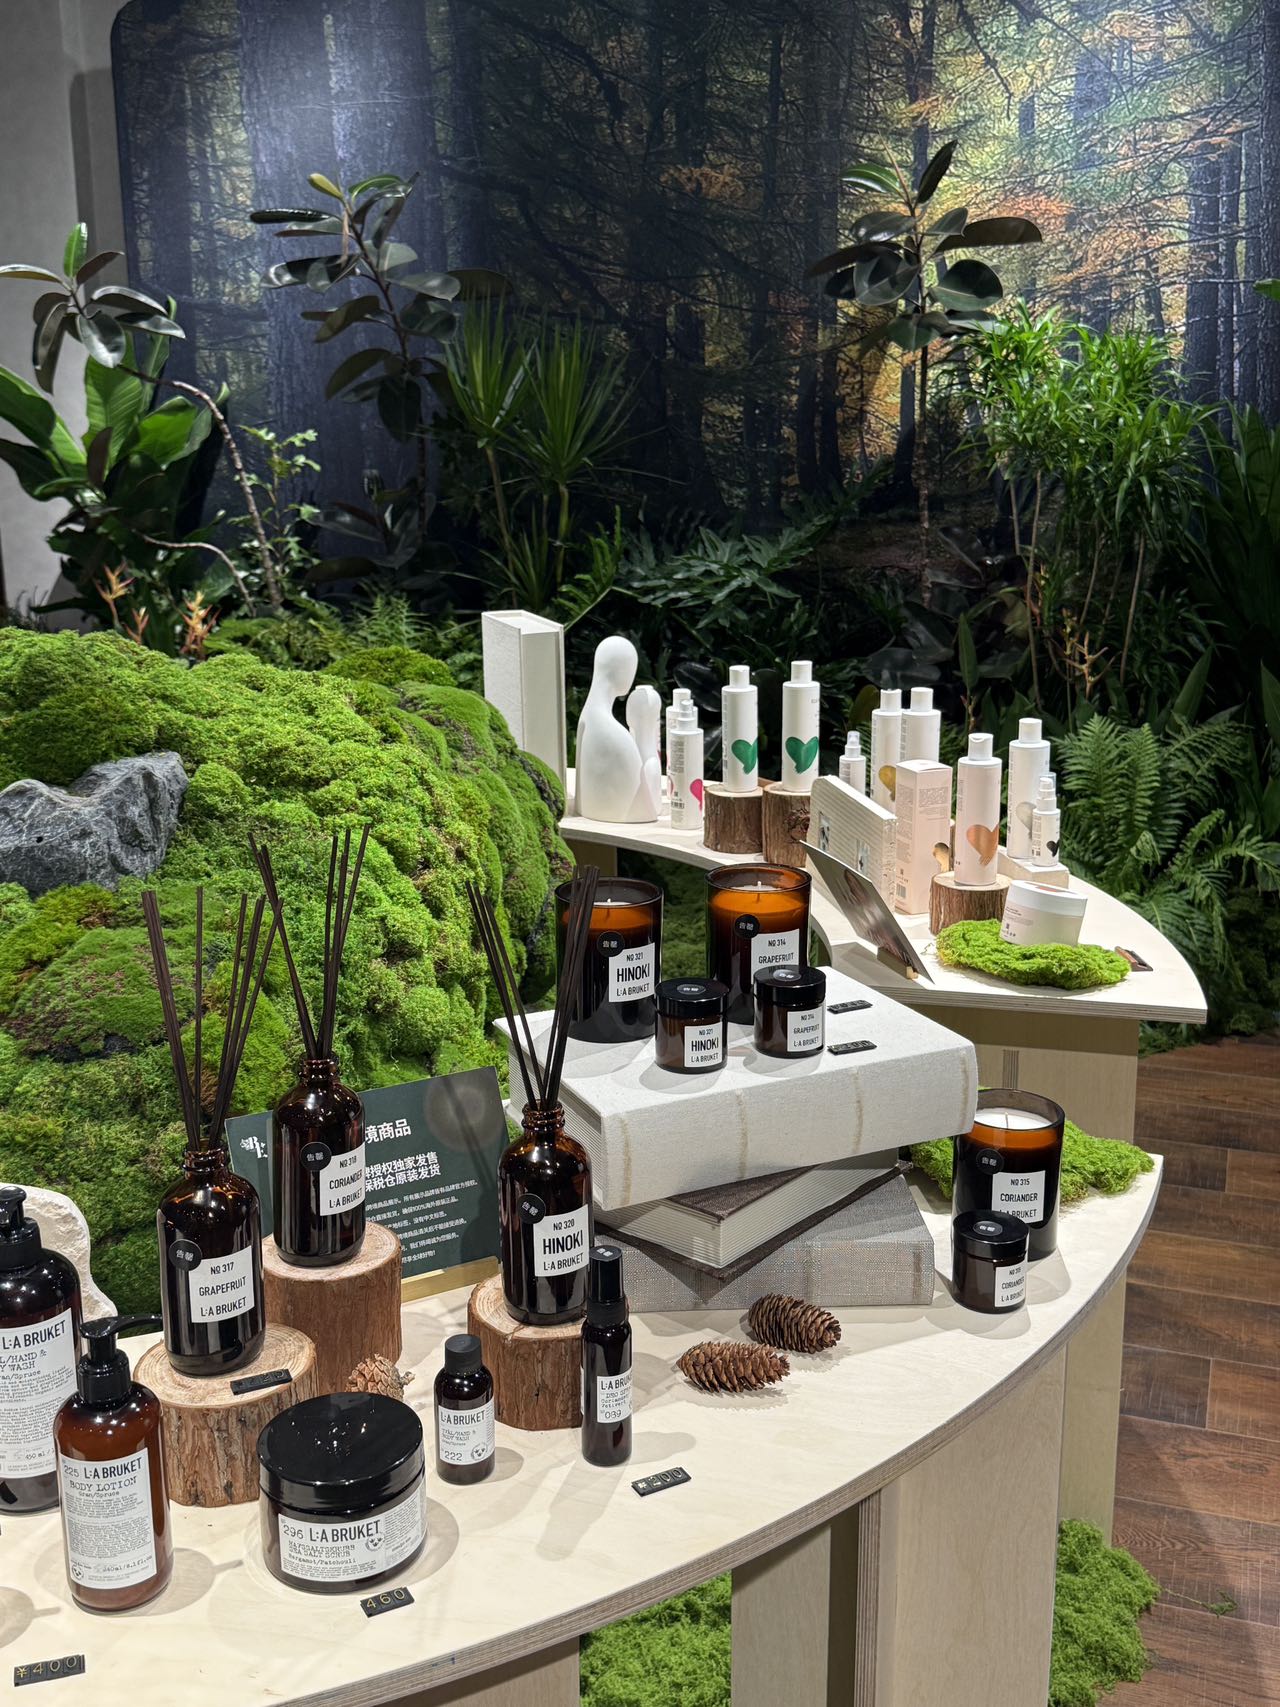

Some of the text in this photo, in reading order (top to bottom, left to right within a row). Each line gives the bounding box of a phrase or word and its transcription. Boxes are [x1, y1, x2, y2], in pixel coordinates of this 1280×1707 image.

[758, 952, 794, 964] GRAPEFRUIT
[616, 963, 650, 982] HINOKI
[628, 983, 650, 996] BRUKET
[691, 1037, 719, 1051] HINOKI
[329, 1169, 363, 1190] CORIANDER
[342, 1188, 363, 1206] BRUKET
[1000, 1192, 1038, 1202] CORIANDER
[564, 1218, 575, 1230] 320
[543, 1229, 583, 1255] HINOKI
[222, 1261, 234, 1272] 317
[543, 1261, 556, 1271] L:A
[557, 1252, 584, 1270] BRUKET
[199, 1276, 247, 1297] GRAPEFRUIT
[200, 1296, 247, 1317] L:A BRUKET
[2, 1319, 66, 1350] L:A BRUKET
[453, 1409, 486, 1425] BRUKET
[444, 1450, 463, 1461] 222
[63, 1465, 80, 1478] 225
[84, 1467, 100, 1480] L:A
[102, 1457, 142, 1479] BRUKET
[69, 1475, 137, 1492] BODY LOTION
[283, 1519, 380, 1543] 296 L:A BRUKET
[366, 1588, 406, 1608] 460
[16, 1656, 77, 1678] ¥400
